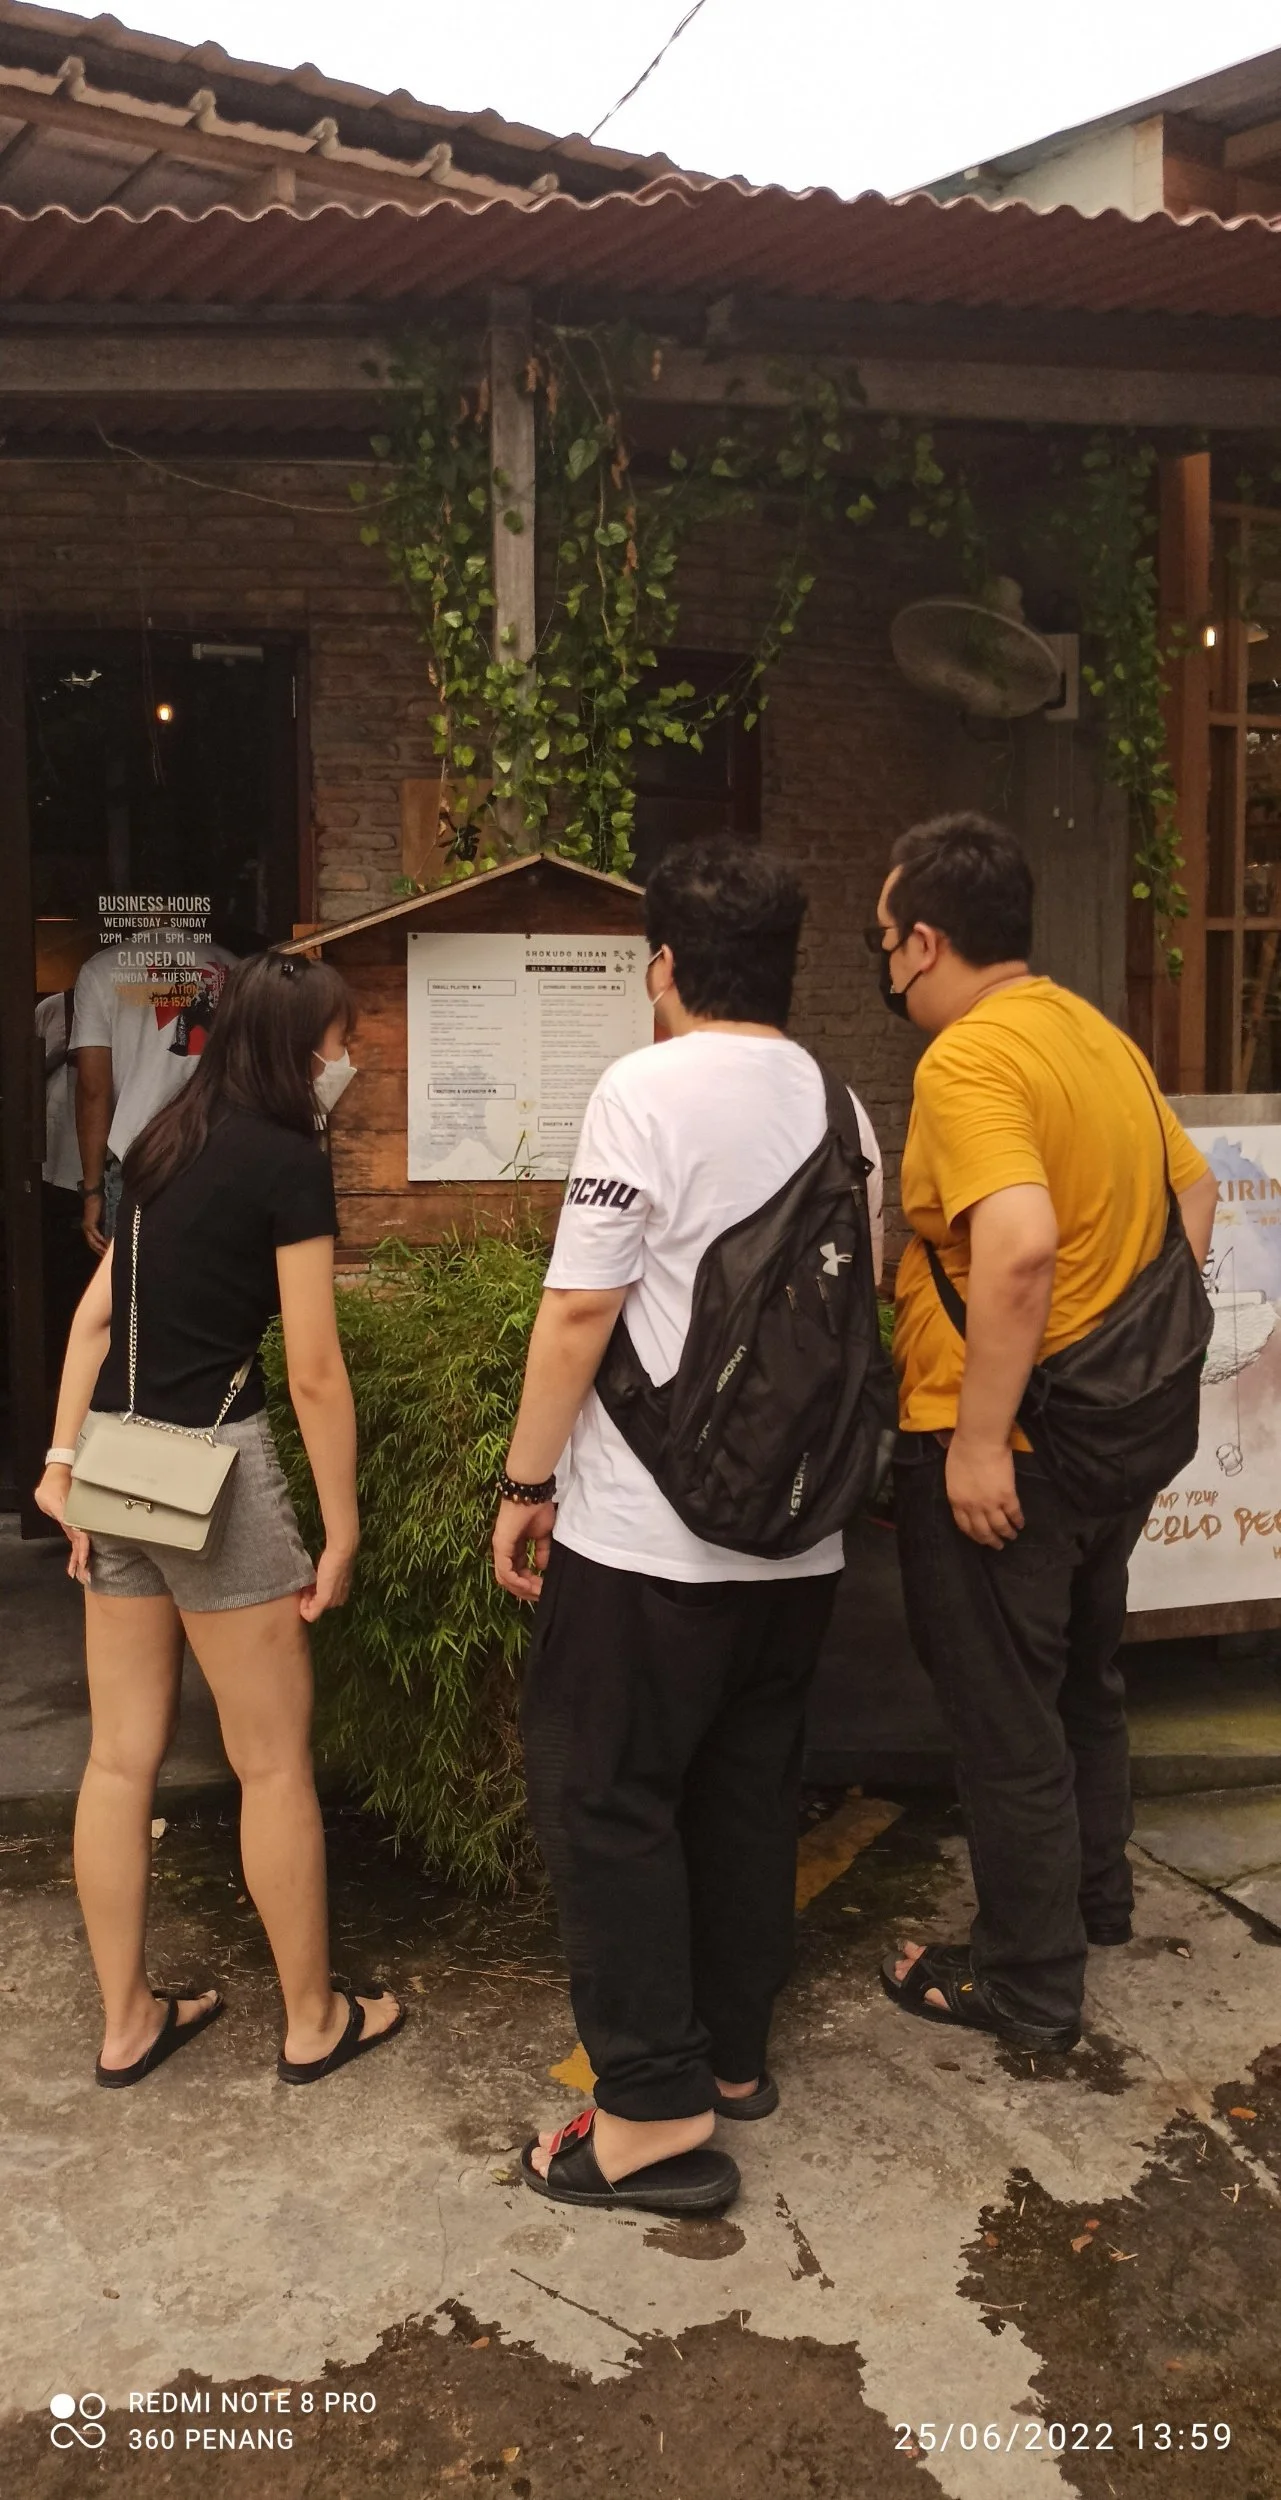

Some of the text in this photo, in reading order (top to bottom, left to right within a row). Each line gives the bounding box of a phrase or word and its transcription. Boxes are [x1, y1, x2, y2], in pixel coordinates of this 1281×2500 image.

[98, 896, 211, 912] BUSINESS HOURS
[104, 917, 161, 928] WEDNESDAY
[170, 918, 207, 928] SUNDAY
[100, 933, 122, 944] 12PM
[132, 933, 150, 944] 3PM
[165, 933, 184, 944] 5PM
[193, 933, 212, 944] 9PM
[118, 951, 196, 967] CLOSED ON
[525, 950, 572, 958] SHOKUDO
[112, 972, 203, 983] MONDAY & TUESDAY
[1143, 1514, 1222, 1545] COLD
